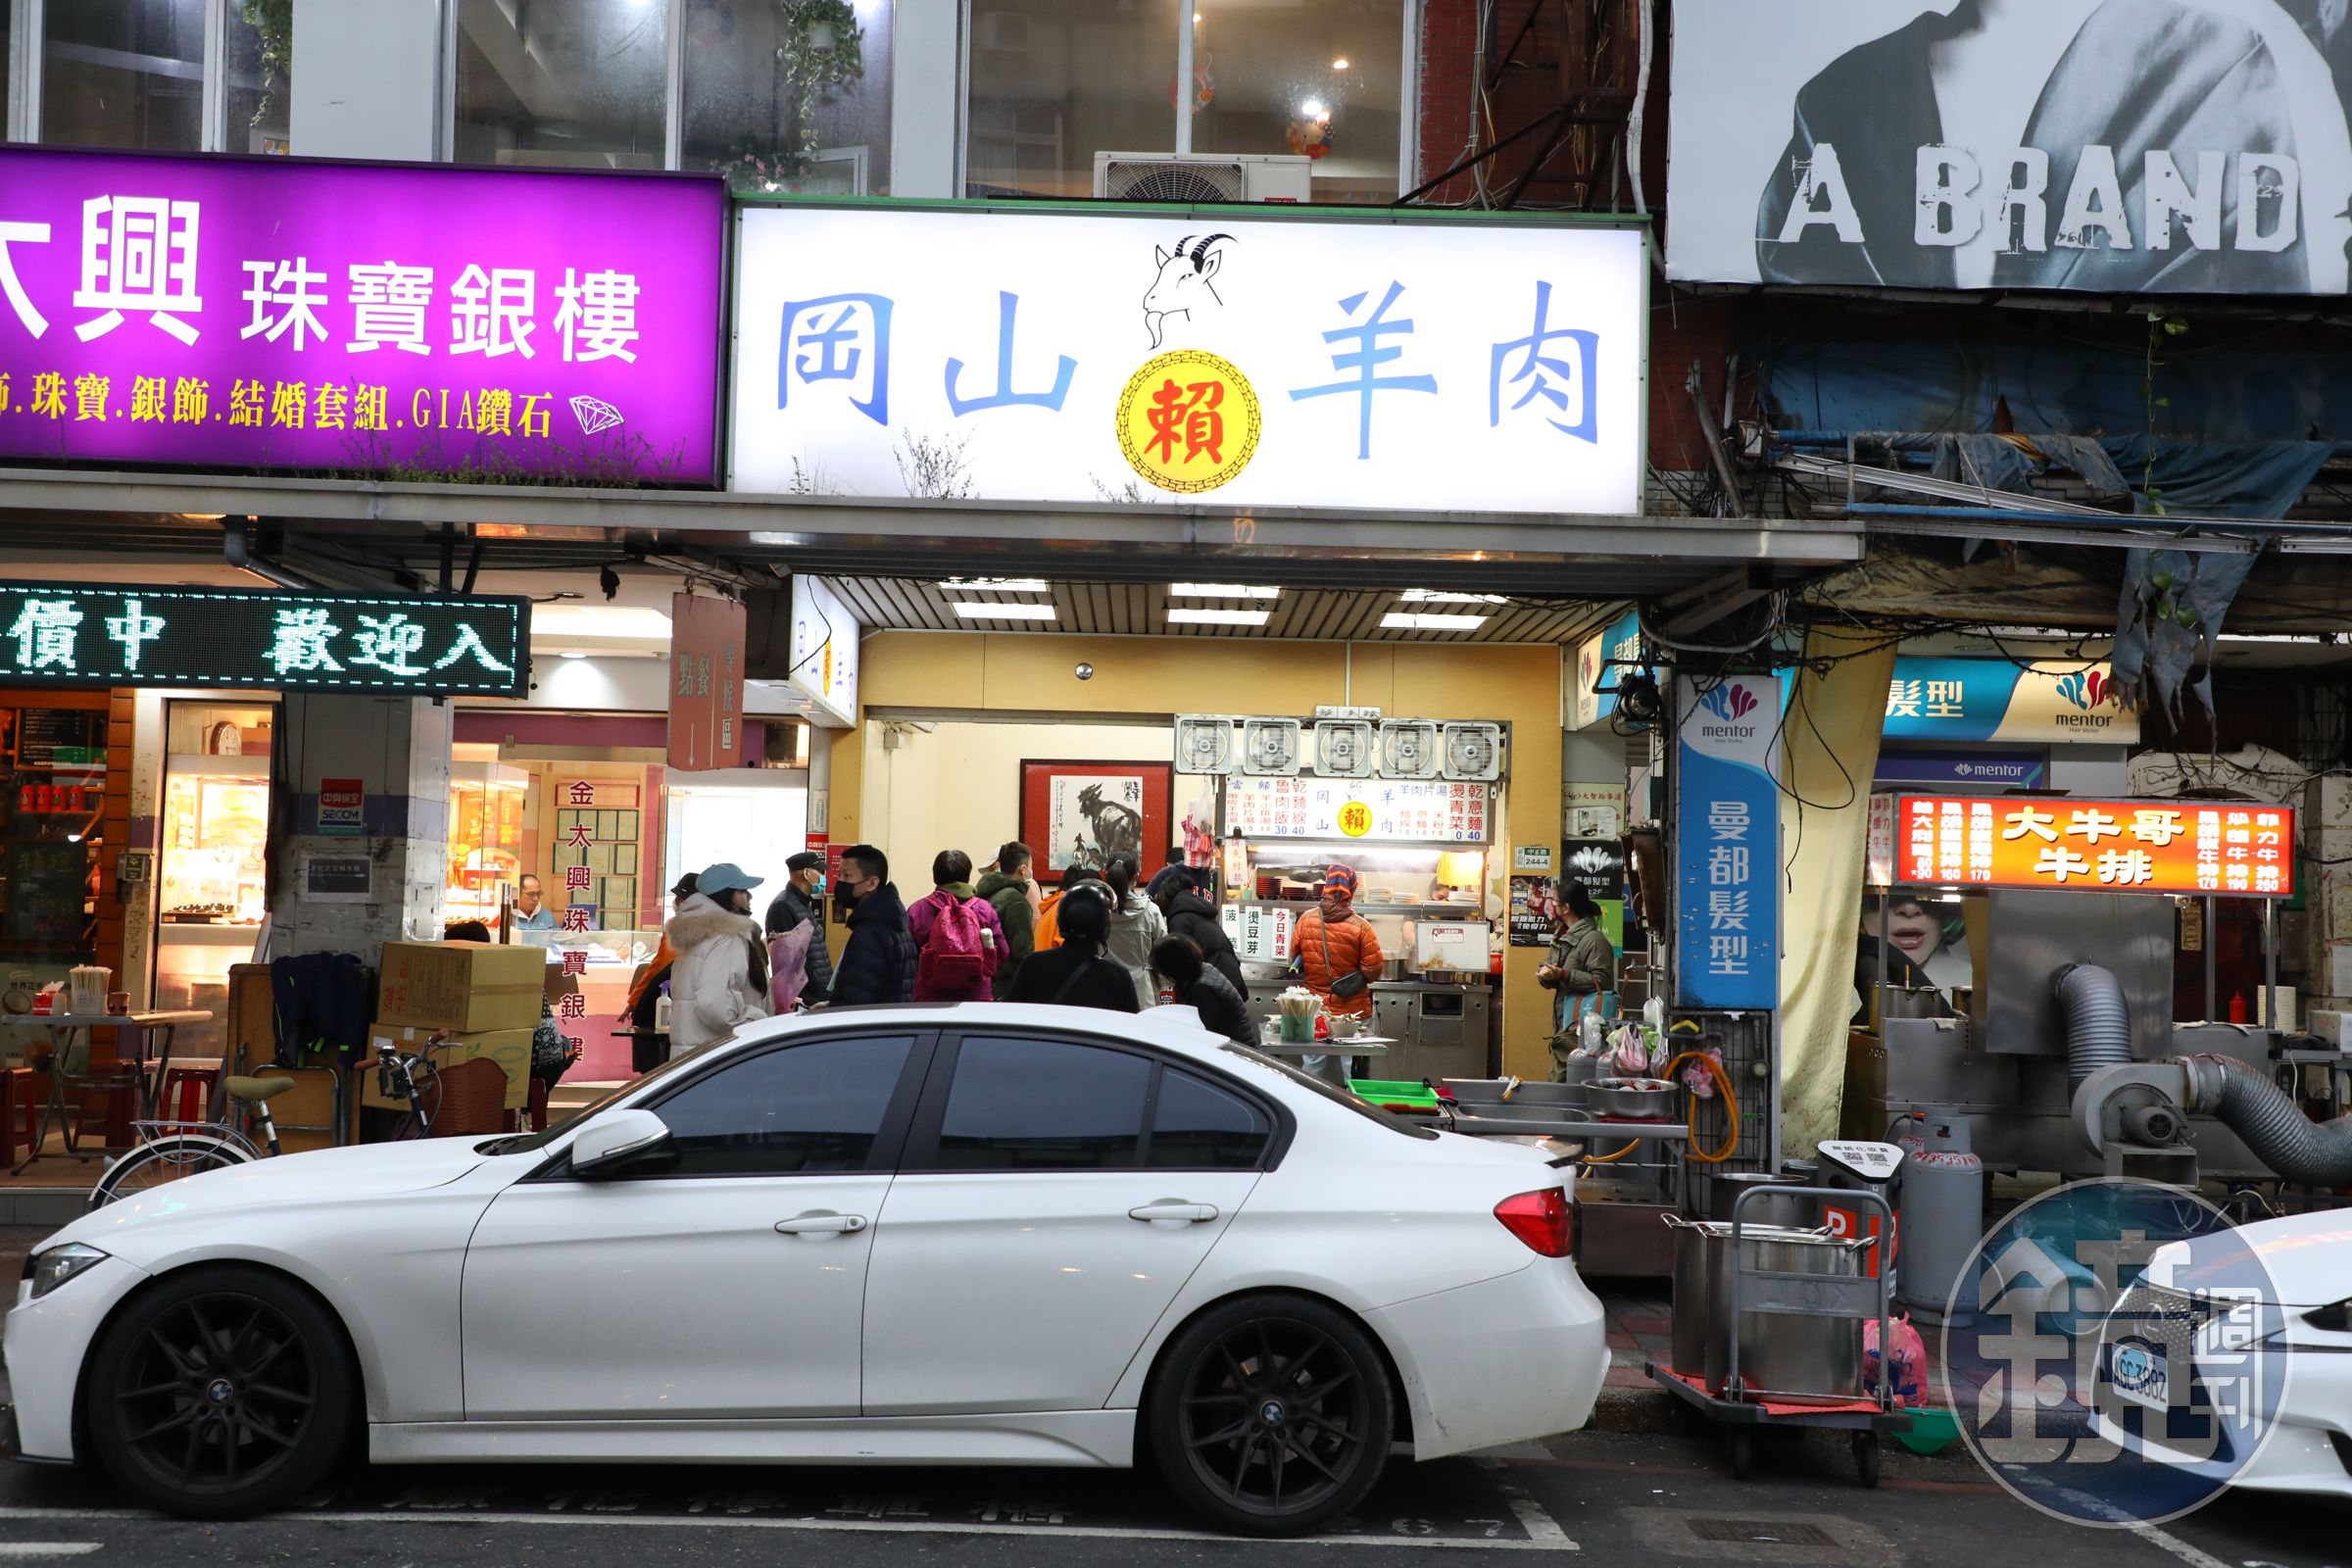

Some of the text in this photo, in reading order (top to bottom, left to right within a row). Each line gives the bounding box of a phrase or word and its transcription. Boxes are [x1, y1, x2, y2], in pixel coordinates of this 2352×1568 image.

[1779, 142, 2300, 253] A BRAND
[240, 257, 642, 366] 珠寶銀樓
[1701, 725, 1756, 739] mentor
[2055, 714, 2114, 727] mentor
[1974, 762, 2024, 777] mentor
[321, 808, 360, 820] SECOM
[2001, 805, 2185, 847] 大牛哥
[1467, 830, 1481, 841] 40
[2034, 845, 2153, 885] 牛排
[1707, 801, 1750, 975] 曼都髮型
